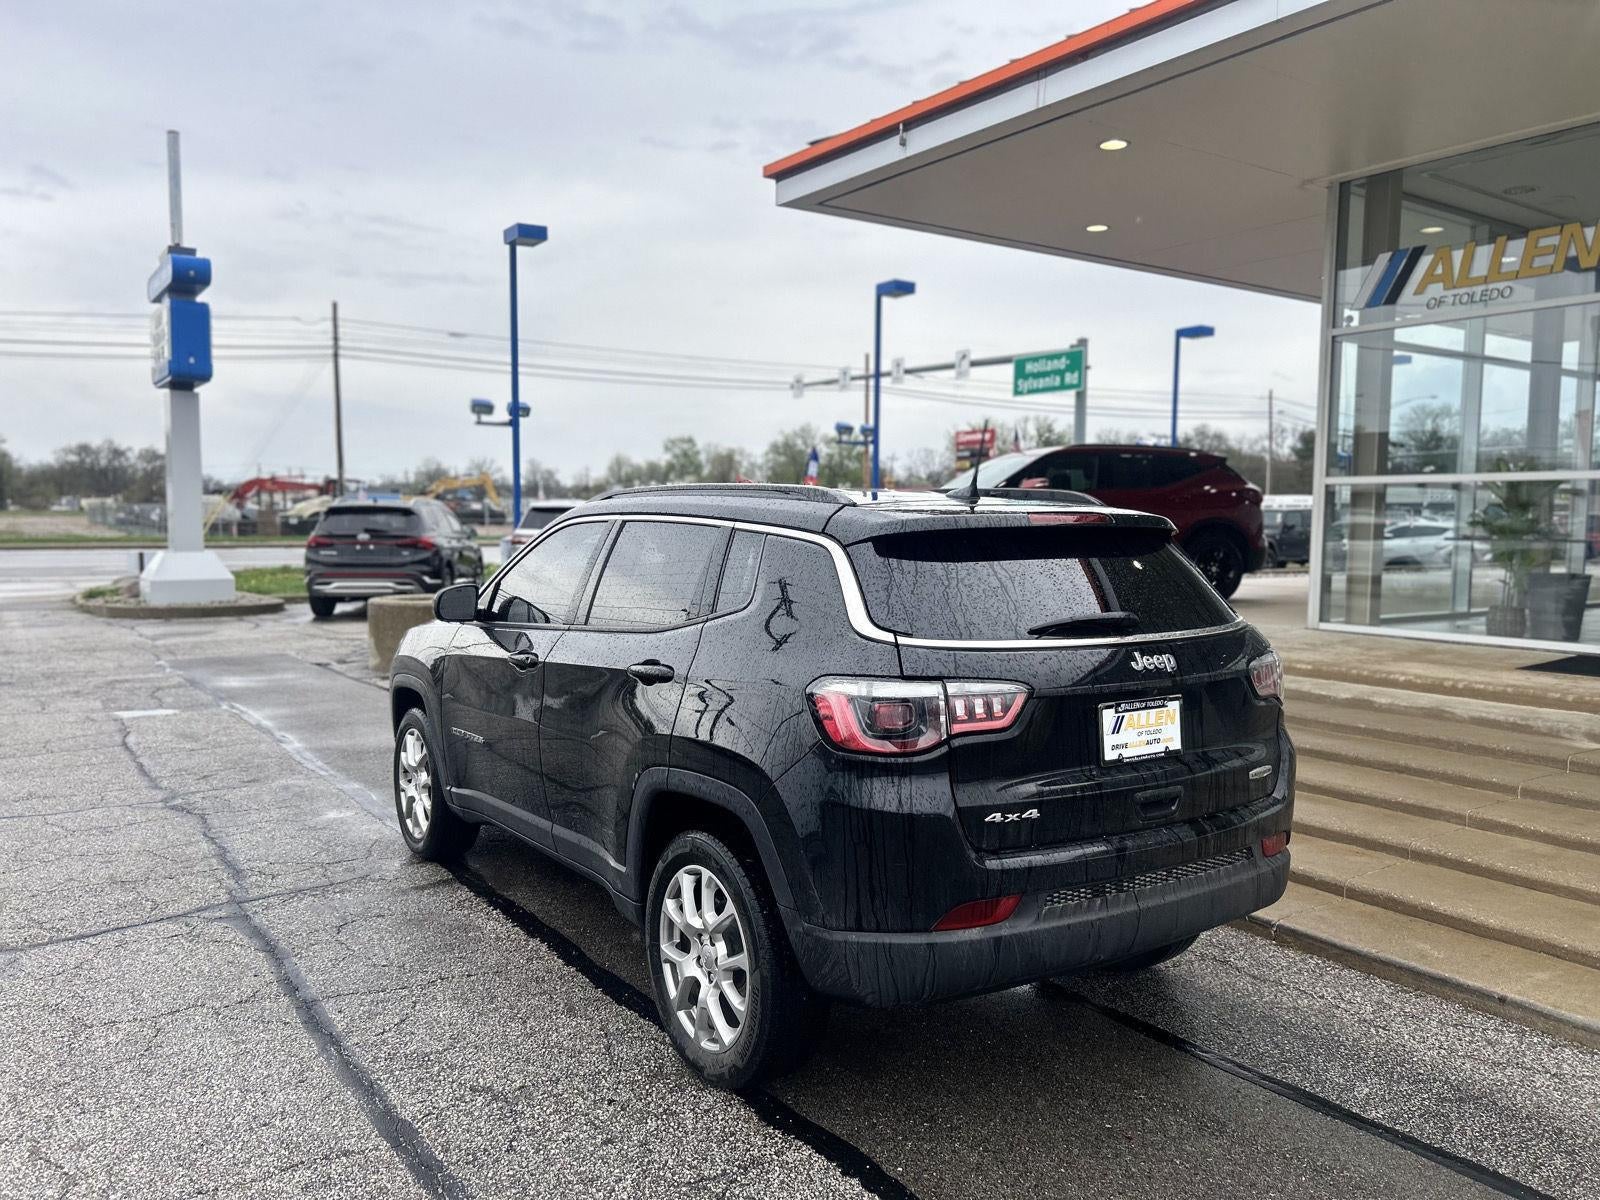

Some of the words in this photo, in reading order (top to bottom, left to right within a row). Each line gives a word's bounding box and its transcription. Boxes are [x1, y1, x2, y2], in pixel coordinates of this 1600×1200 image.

[1412, 219, 1600, 296] ALLEN
[1426, 294, 1446, 310] OF
[1451, 286, 1513, 307] TOLEDO
[1025, 355, 1071, 374] Holland-
[1017, 374, 1060, 393] Sylvania
[1064, 370, 1079, 385] Rd
[1130, 651, 1178, 672] Jeep
[1125, 702, 1140, 710] ALLEN
[1124, 709, 1177, 731] ALLEN
[1145, 728, 1162, 736] TOLEDO
[984, 808, 1041, 823] 4x4
